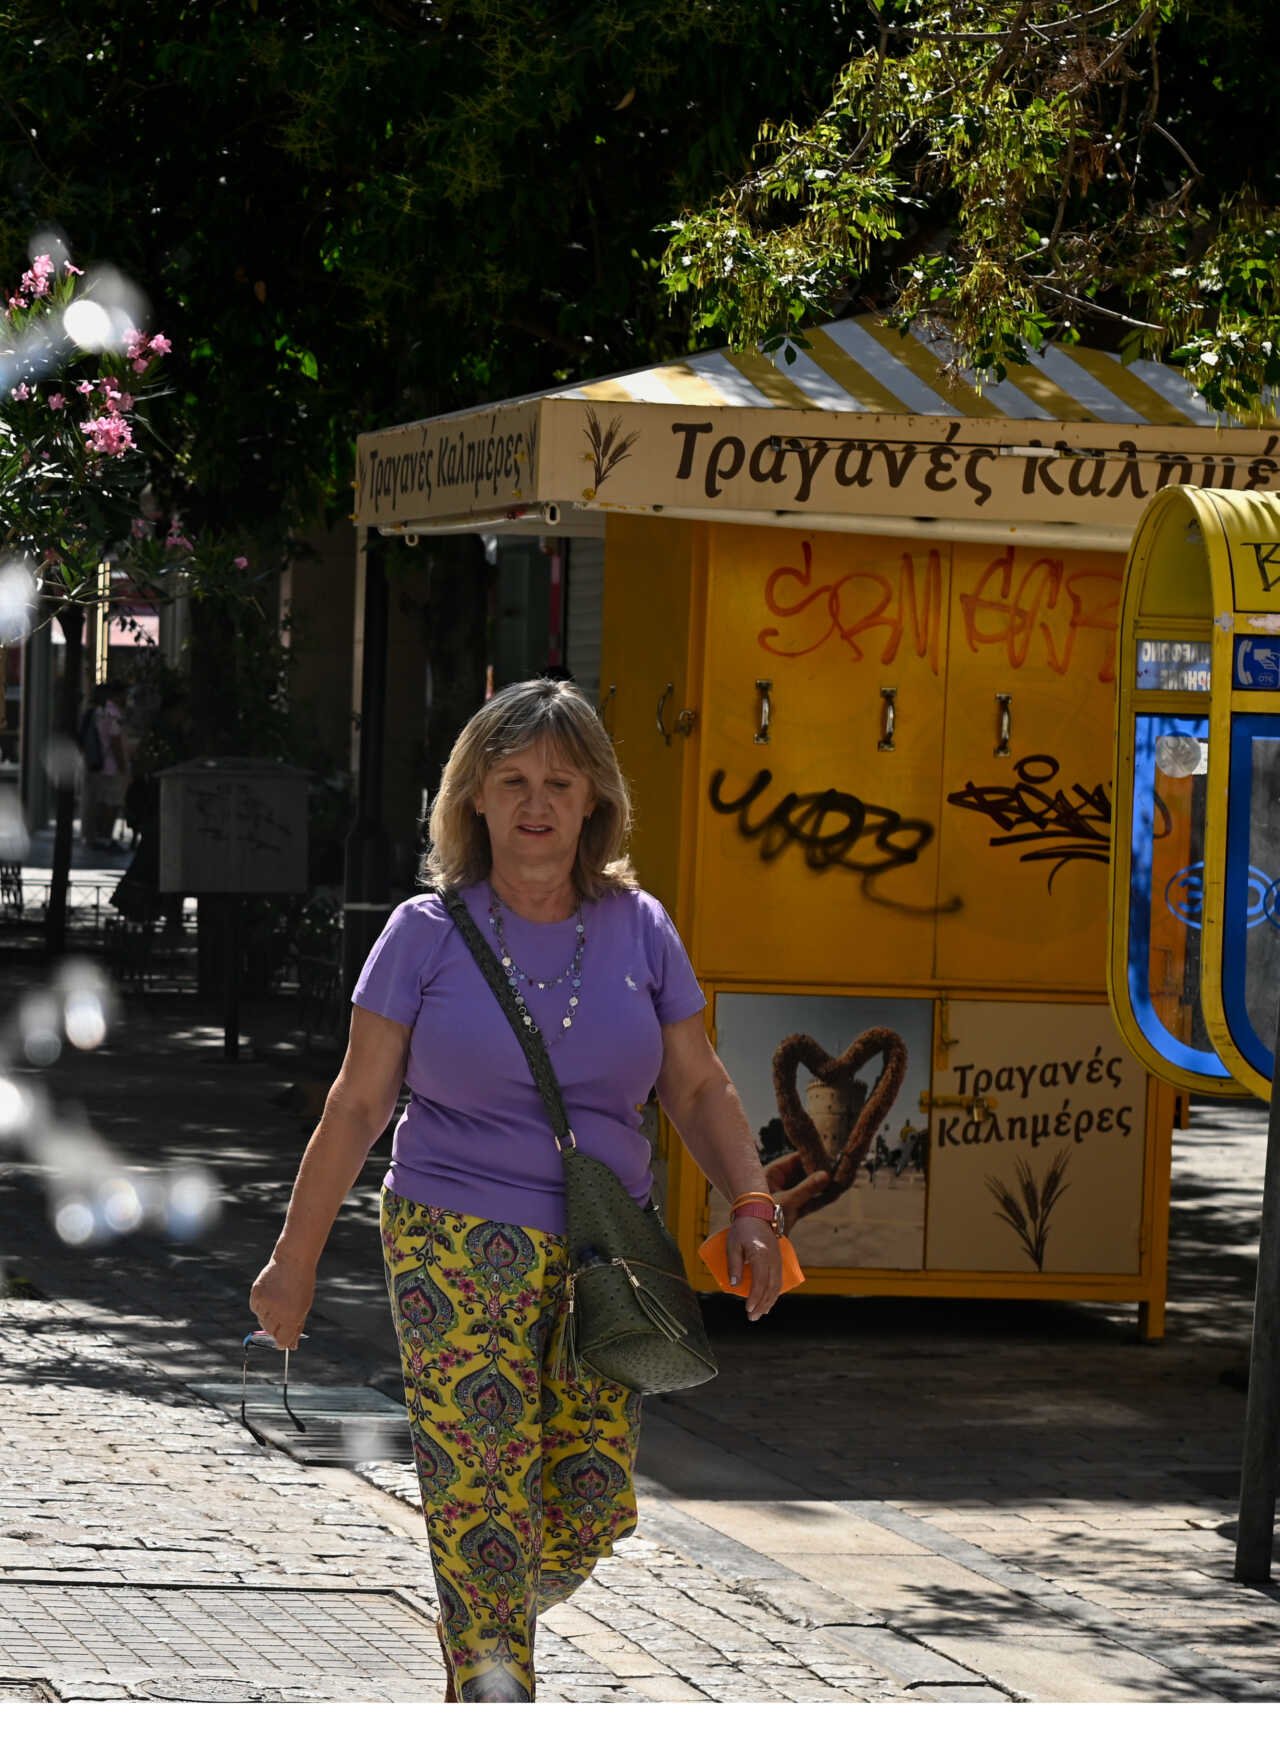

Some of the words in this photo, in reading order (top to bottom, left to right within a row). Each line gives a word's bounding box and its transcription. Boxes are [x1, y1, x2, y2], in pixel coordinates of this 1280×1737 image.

[370, 428, 433, 513] Τραγανές
[437, 415, 522, 498] Καλημέρες
[671, 422, 996, 506] Τραγανές
[953, 1045, 1122, 1098] Τραγανές
[938, 1099, 1132, 1148] Καλημέρες
